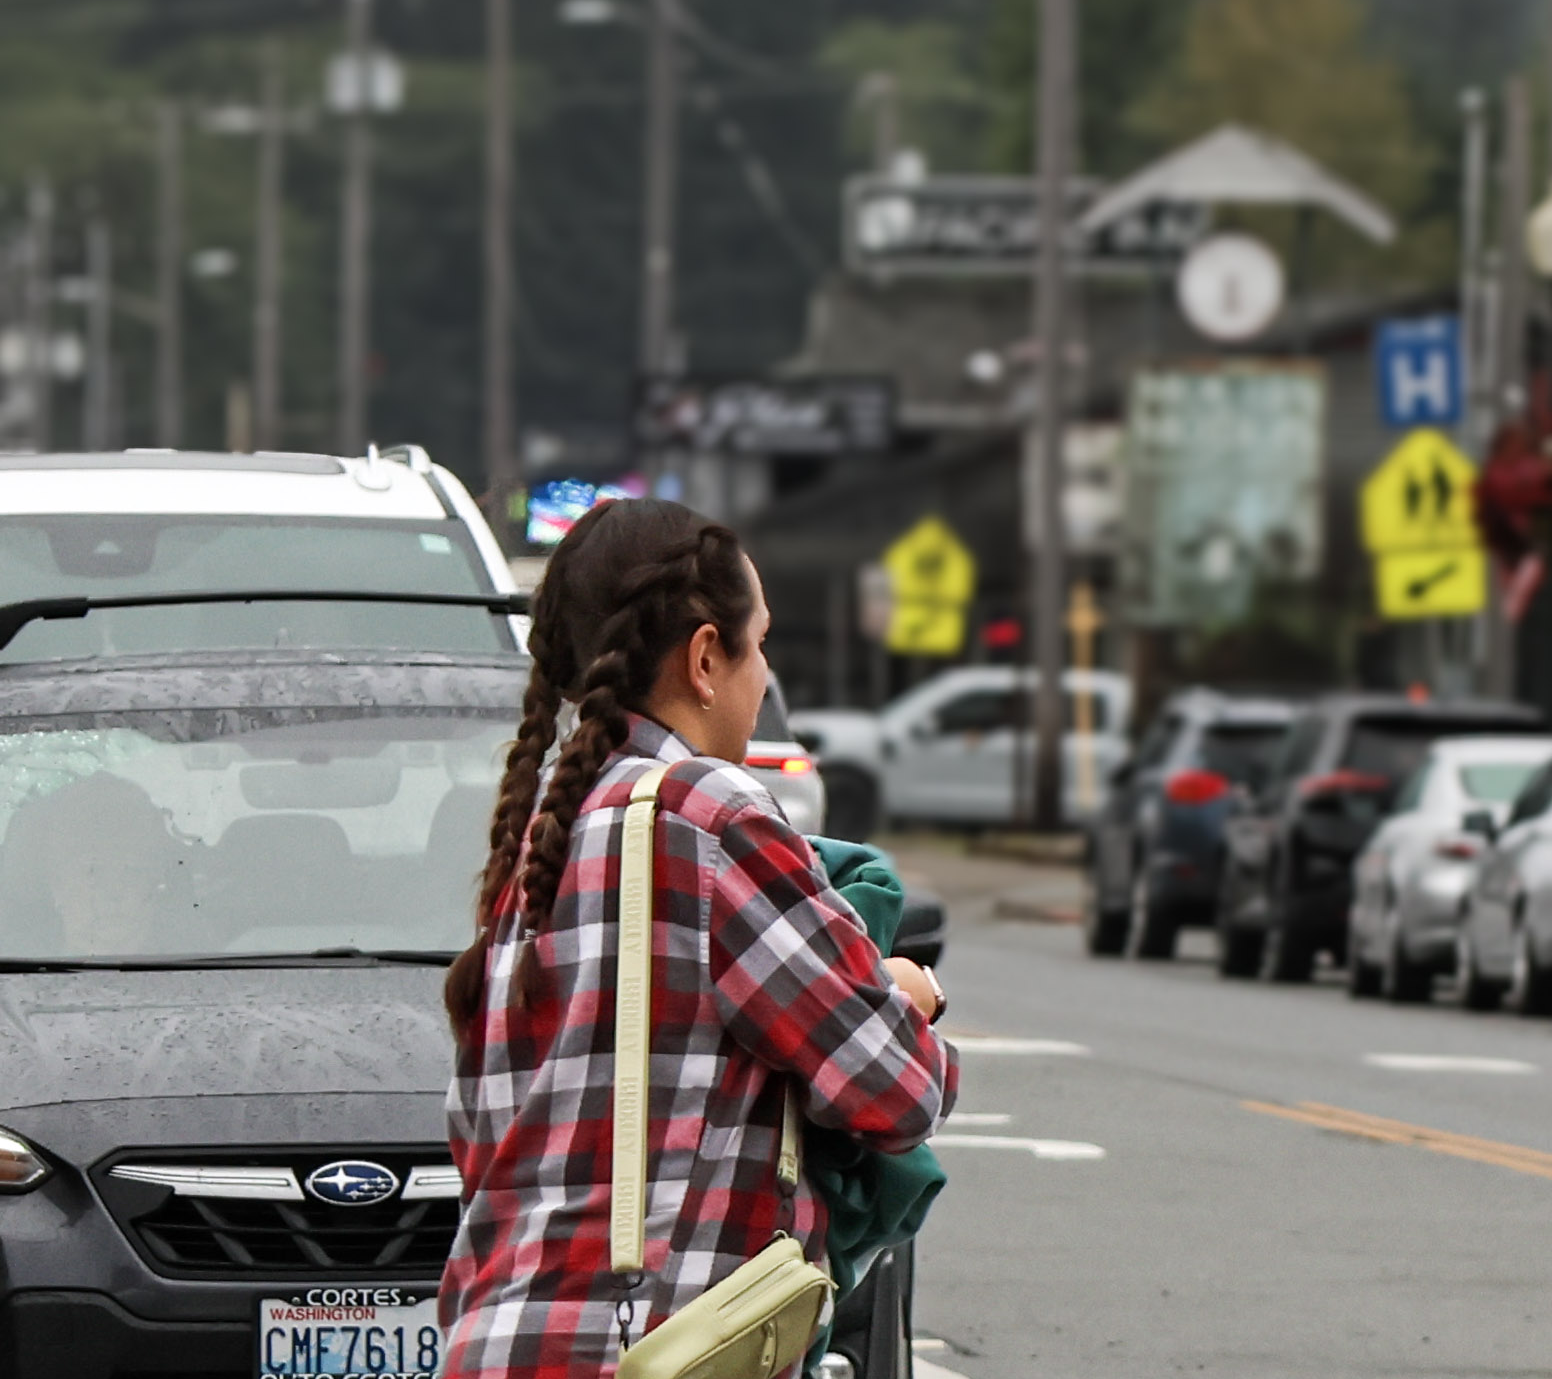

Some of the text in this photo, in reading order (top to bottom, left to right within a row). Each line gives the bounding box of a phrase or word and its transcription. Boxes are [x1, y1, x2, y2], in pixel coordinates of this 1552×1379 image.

[1391, 351, 1451, 418] H
[269, 1307, 376, 1320] WASHINGTON
[306, 1288, 401, 1307] CORTES
[265, 1326, 438, 1372] CMF7618
